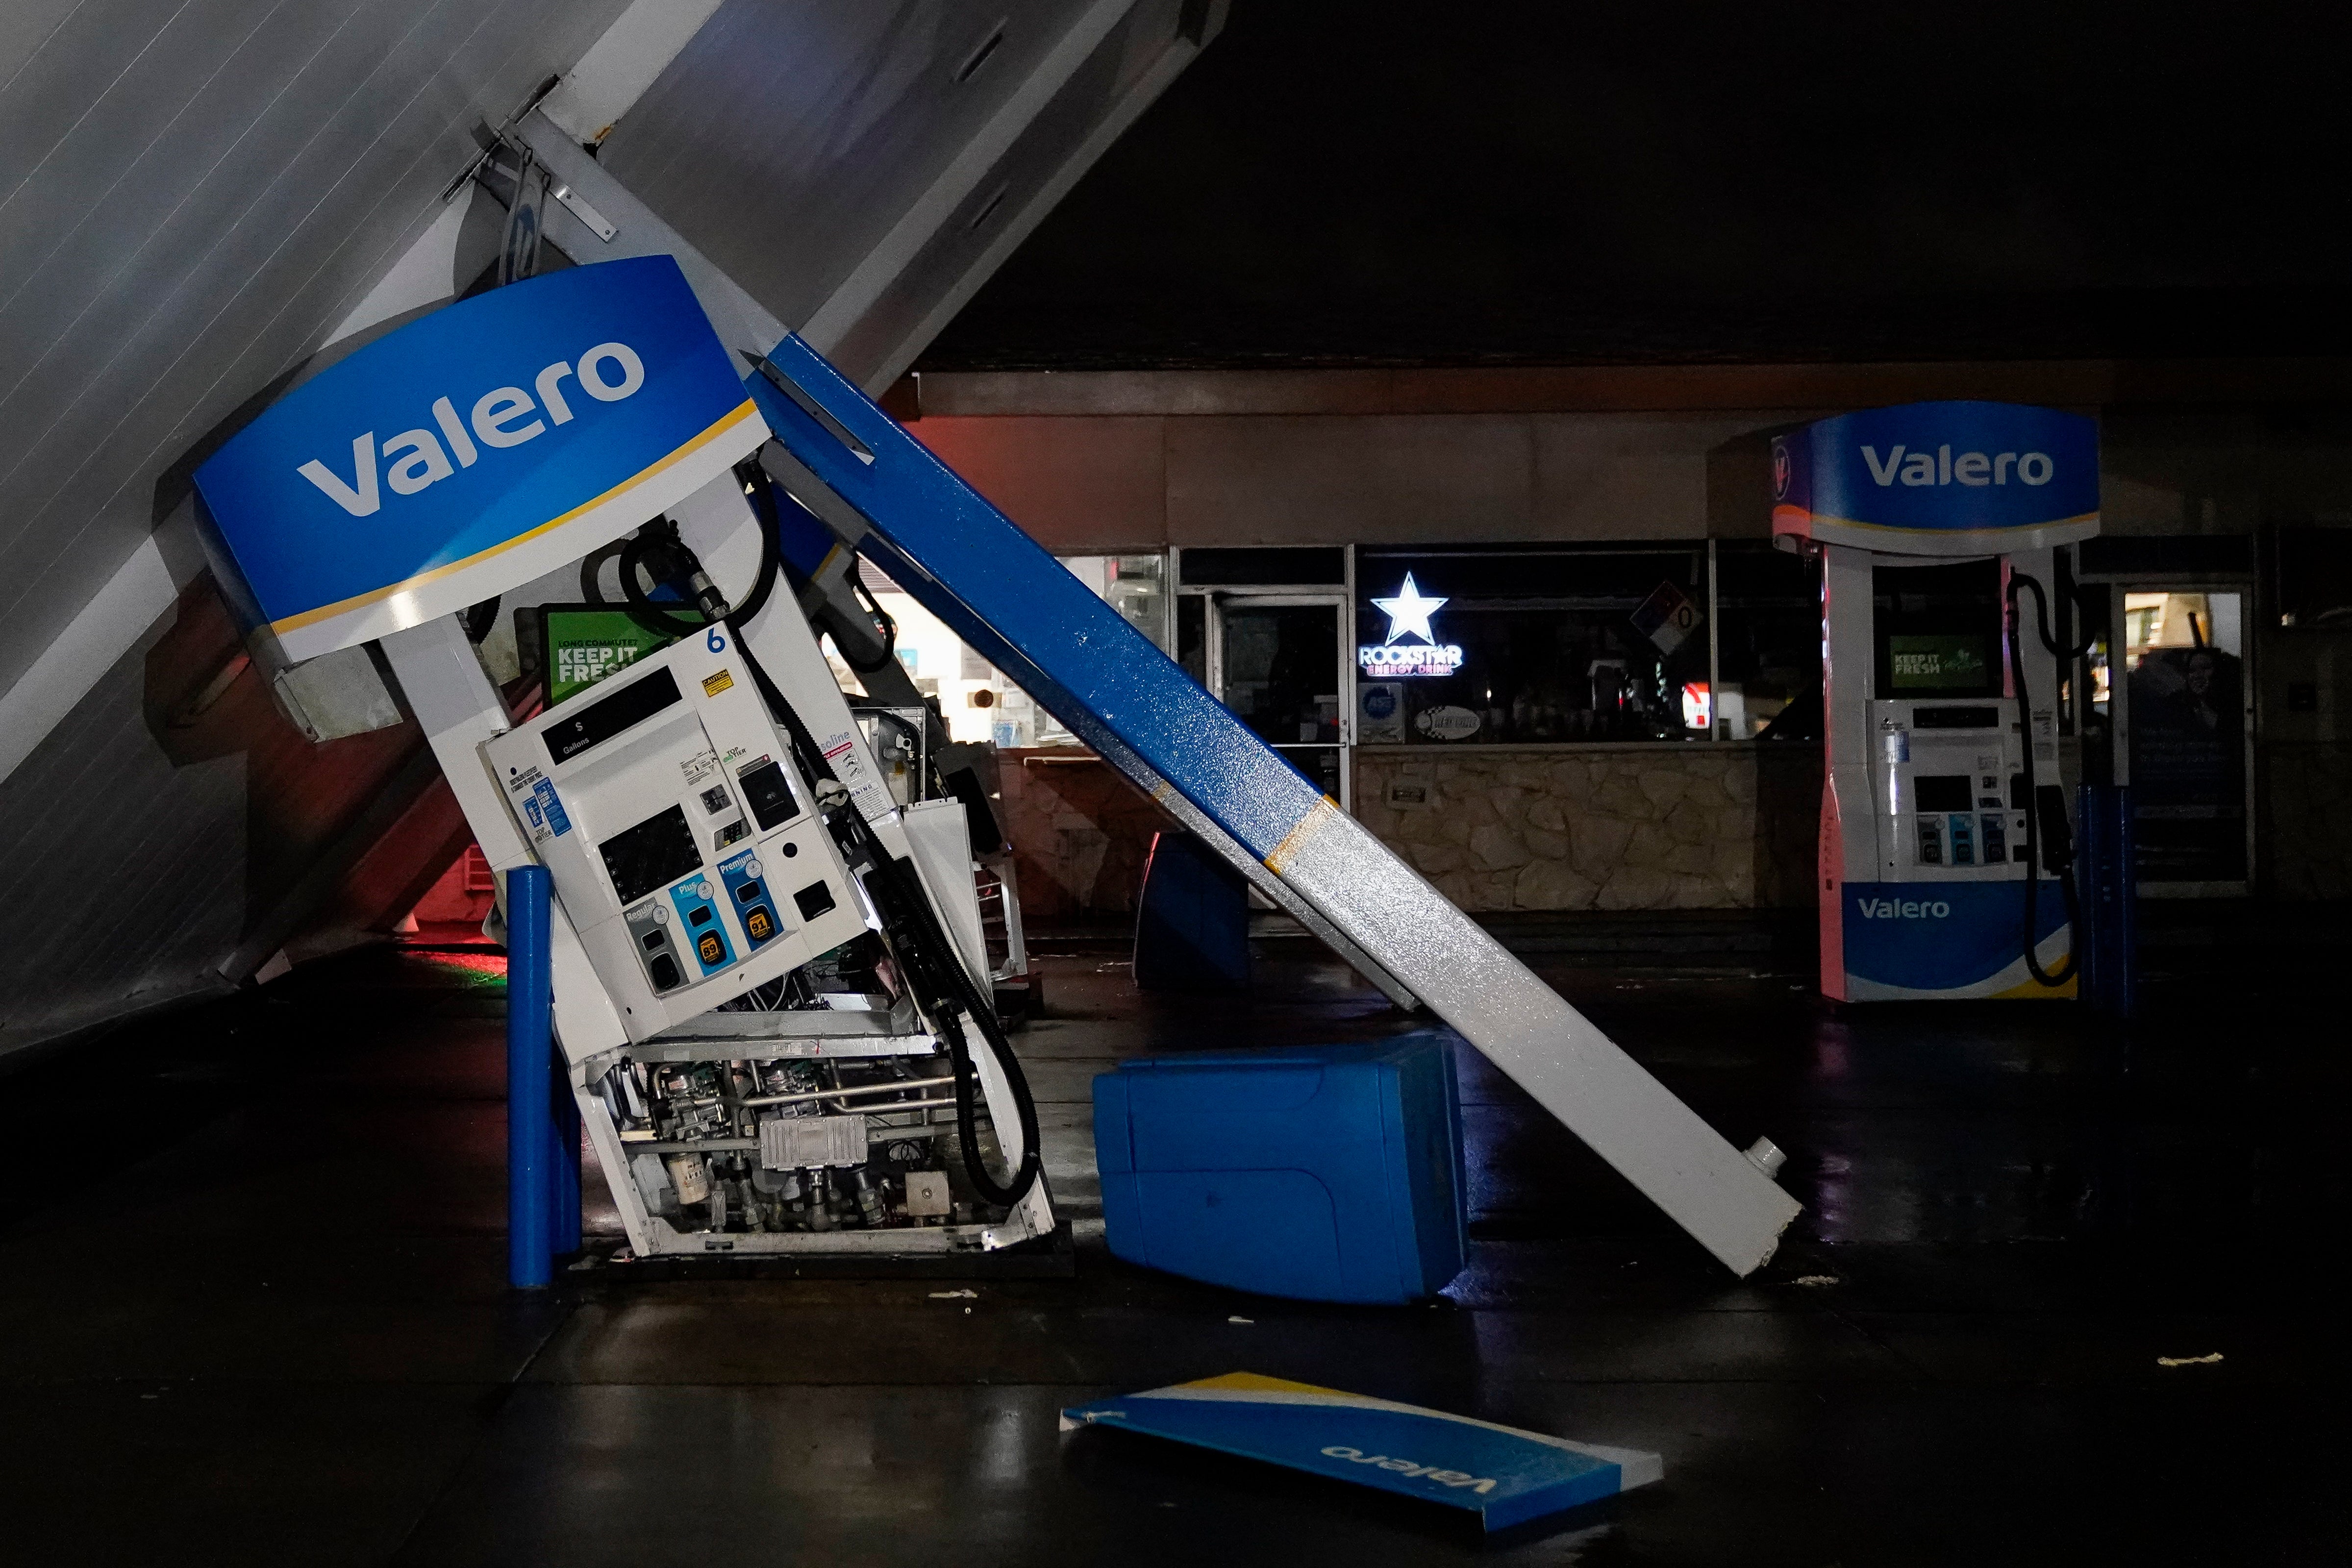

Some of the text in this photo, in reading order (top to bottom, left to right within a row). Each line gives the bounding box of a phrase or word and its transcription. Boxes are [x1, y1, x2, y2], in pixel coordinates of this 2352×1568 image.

[297, 342, 645, 517] Valero
[1860, 444, 2054, 487] Valero
[707, 627, 726, 653] 6
[558, 647, 638, 664] KEEP IT
[1359, 645, 1463, 665] ROCKSTAR
[1895, 654, 1925, 663] KEEP
[559, 663, 627, 682] FRES
[703, 670, 728, 686] CAUTION
[1367, 664, 1452, 674] ENERGY DRINK
[563, 737, 589, 754] Gallons
[820, 731, 851, 752] soline
[726, 747, 739, 755] TOP
[734, 748, 747, 758] TIER
[851, 784, 872, 797] RNING
[720, 853, 754, 874] Premium
[626, 901, 656, 921] Regular
[1858, 898, 1950, 919] Valero
[751, 921, 766, 933] 91
[703, 945, 717, 957] 89
[1321, 1446, 1497, 1494] Valero
